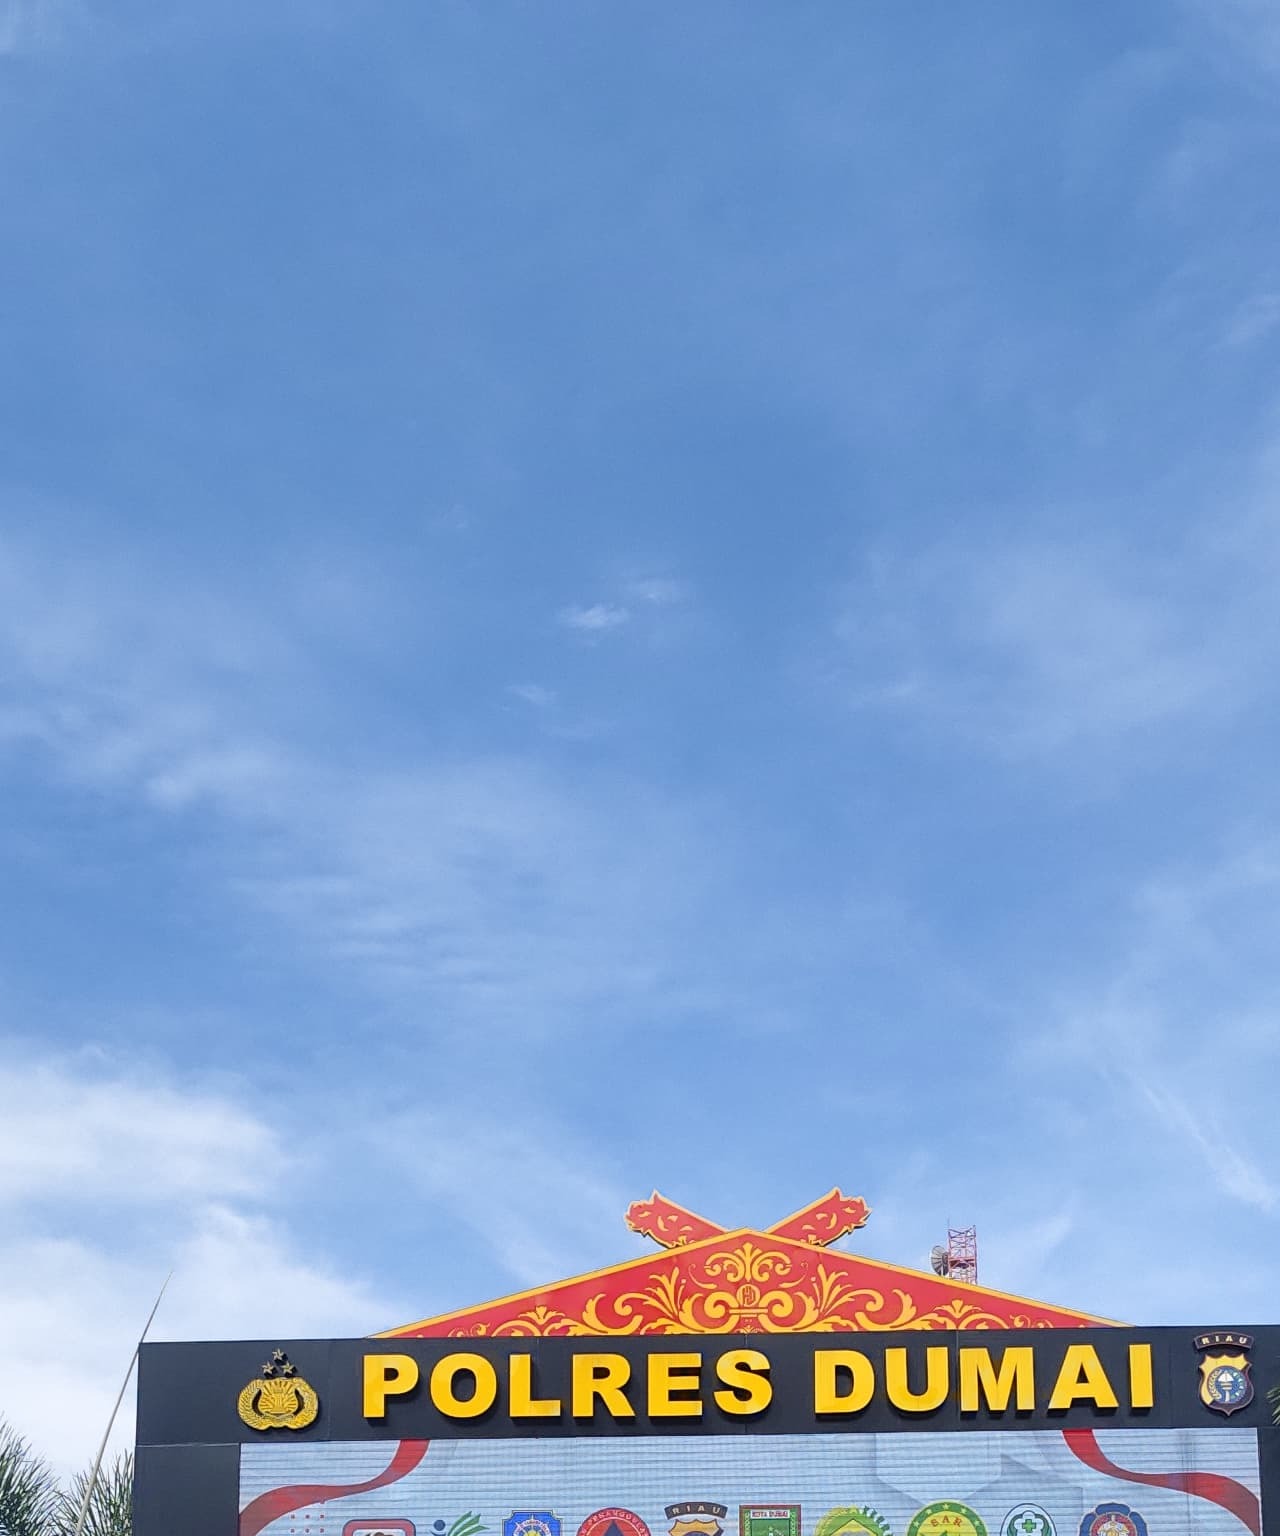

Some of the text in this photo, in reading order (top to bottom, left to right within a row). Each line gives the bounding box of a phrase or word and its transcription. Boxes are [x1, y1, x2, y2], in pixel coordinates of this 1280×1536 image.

[1202, 1335, 1248, 1344] RIAU
[362, 1342, 1156, 1419] POLRES DUMAI
[671, 1505, 721, 1515] RIAU
[930, 1515, 962, 1527] SAR
